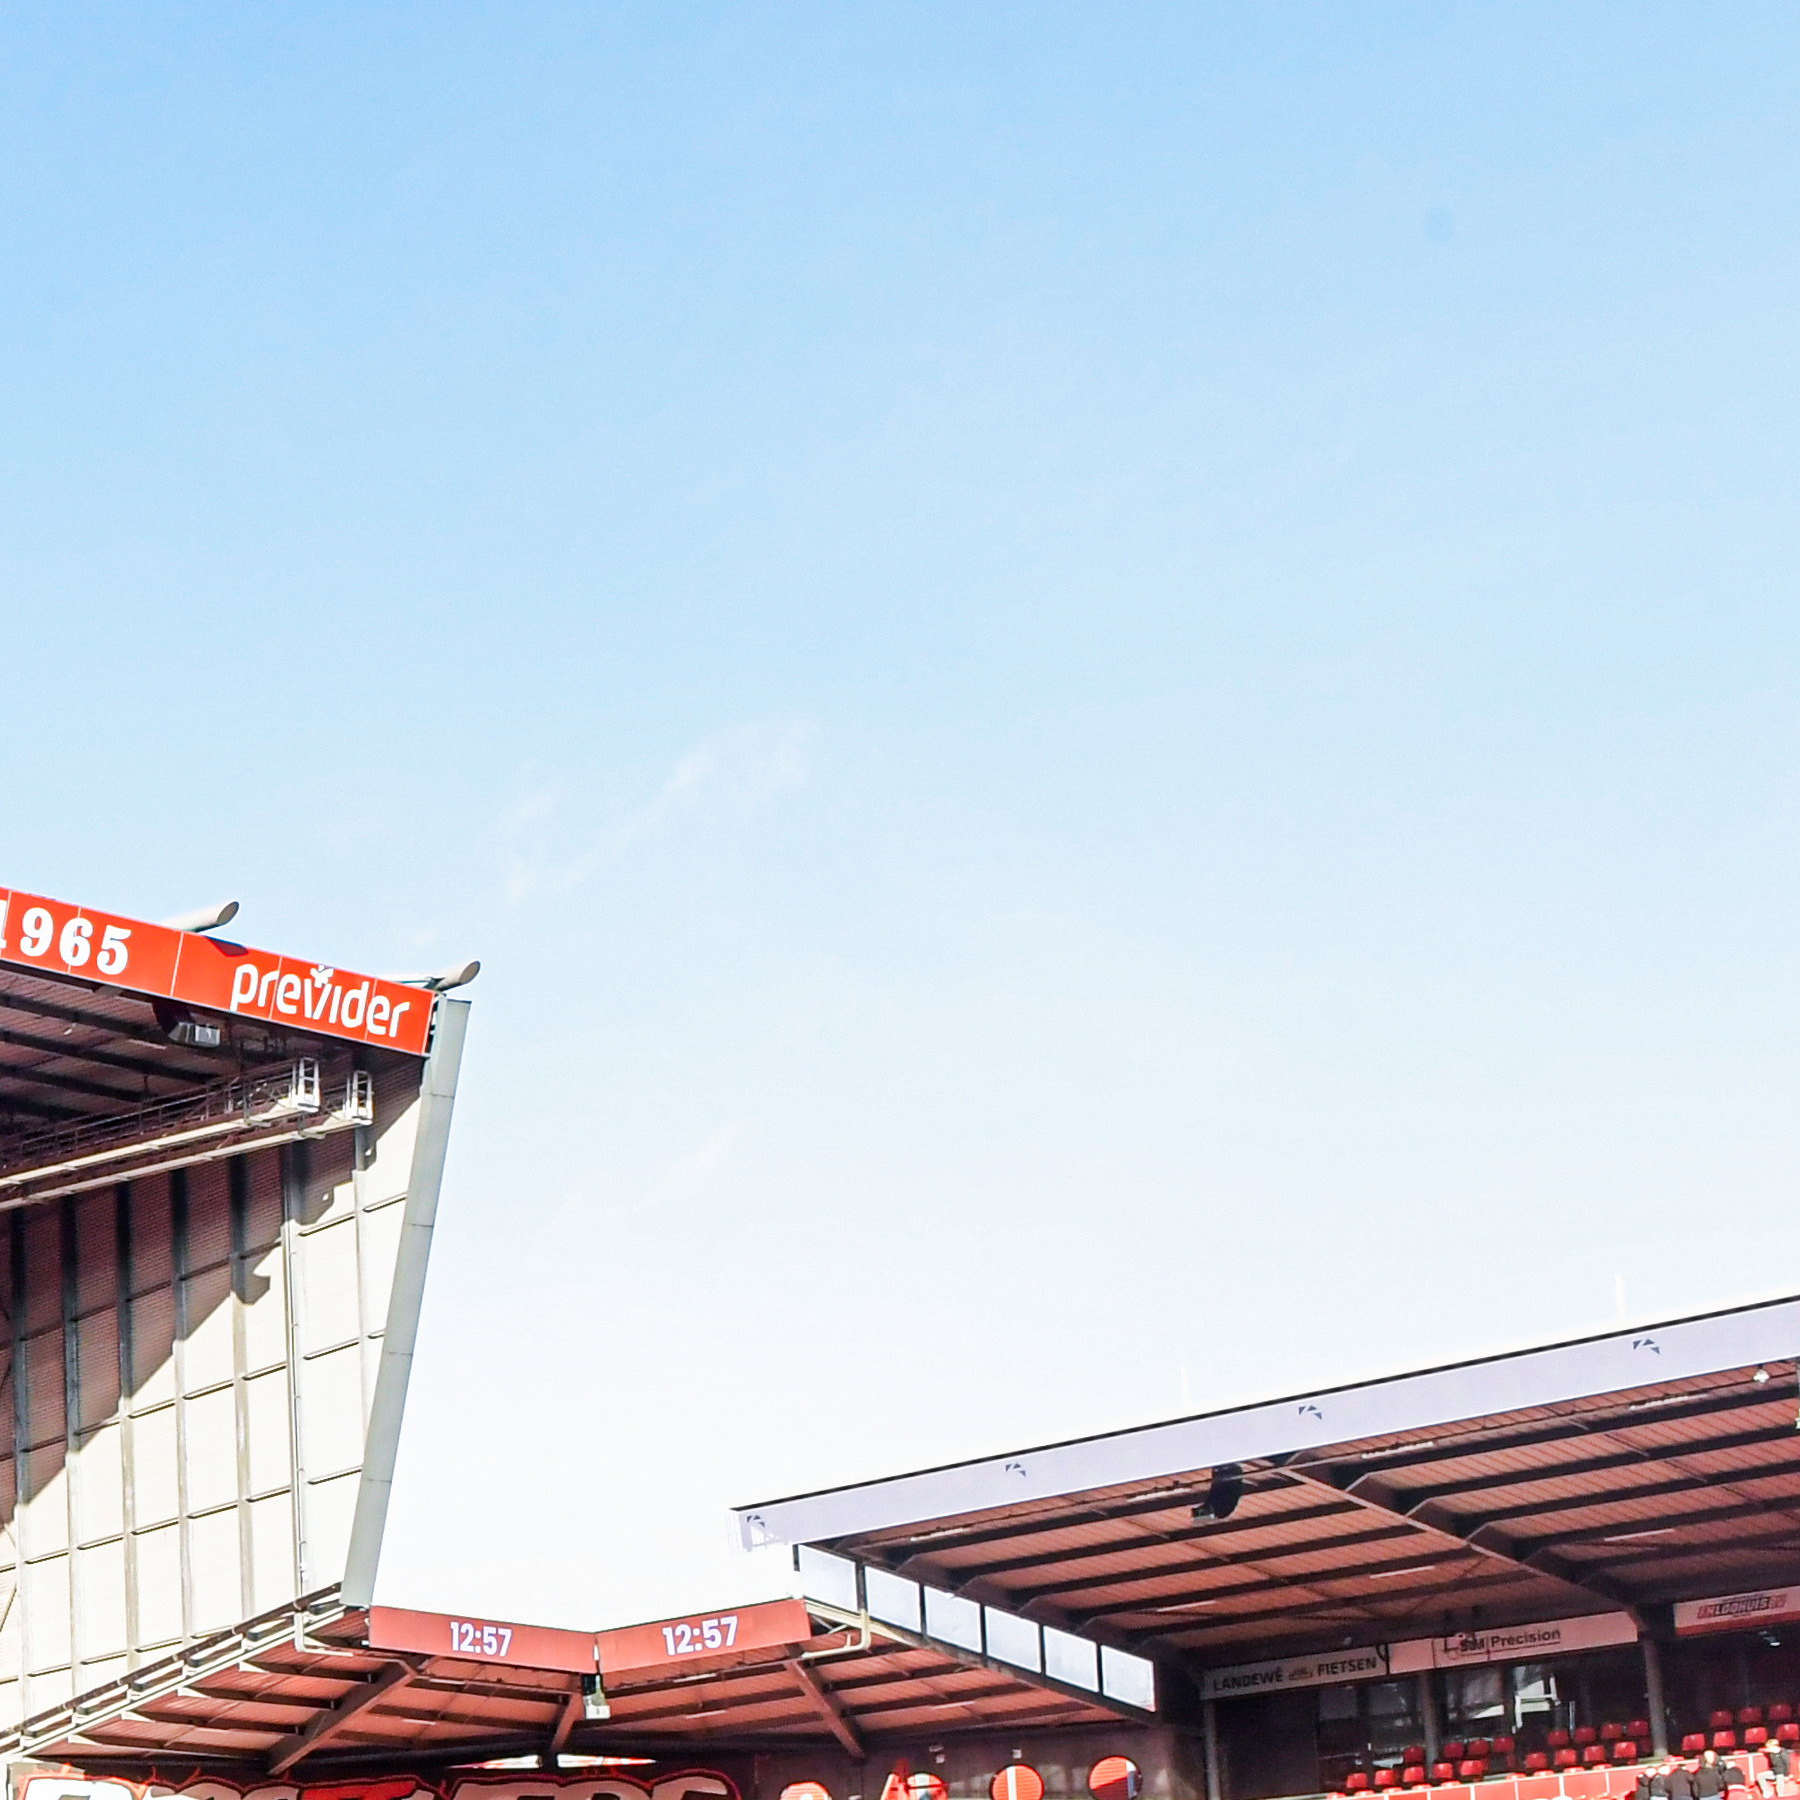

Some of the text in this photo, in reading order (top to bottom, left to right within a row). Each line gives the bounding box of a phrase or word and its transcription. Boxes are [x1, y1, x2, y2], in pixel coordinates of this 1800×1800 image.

[232, 963, 410, 1039] previder
[450, 1621, 512, 1657] 12:57
[662, 1616, 738, 1655] 12:57
[1490, 1629, 1561, 1649] Precision
[1317, 1657, 1377, 1677] FIETSEN
